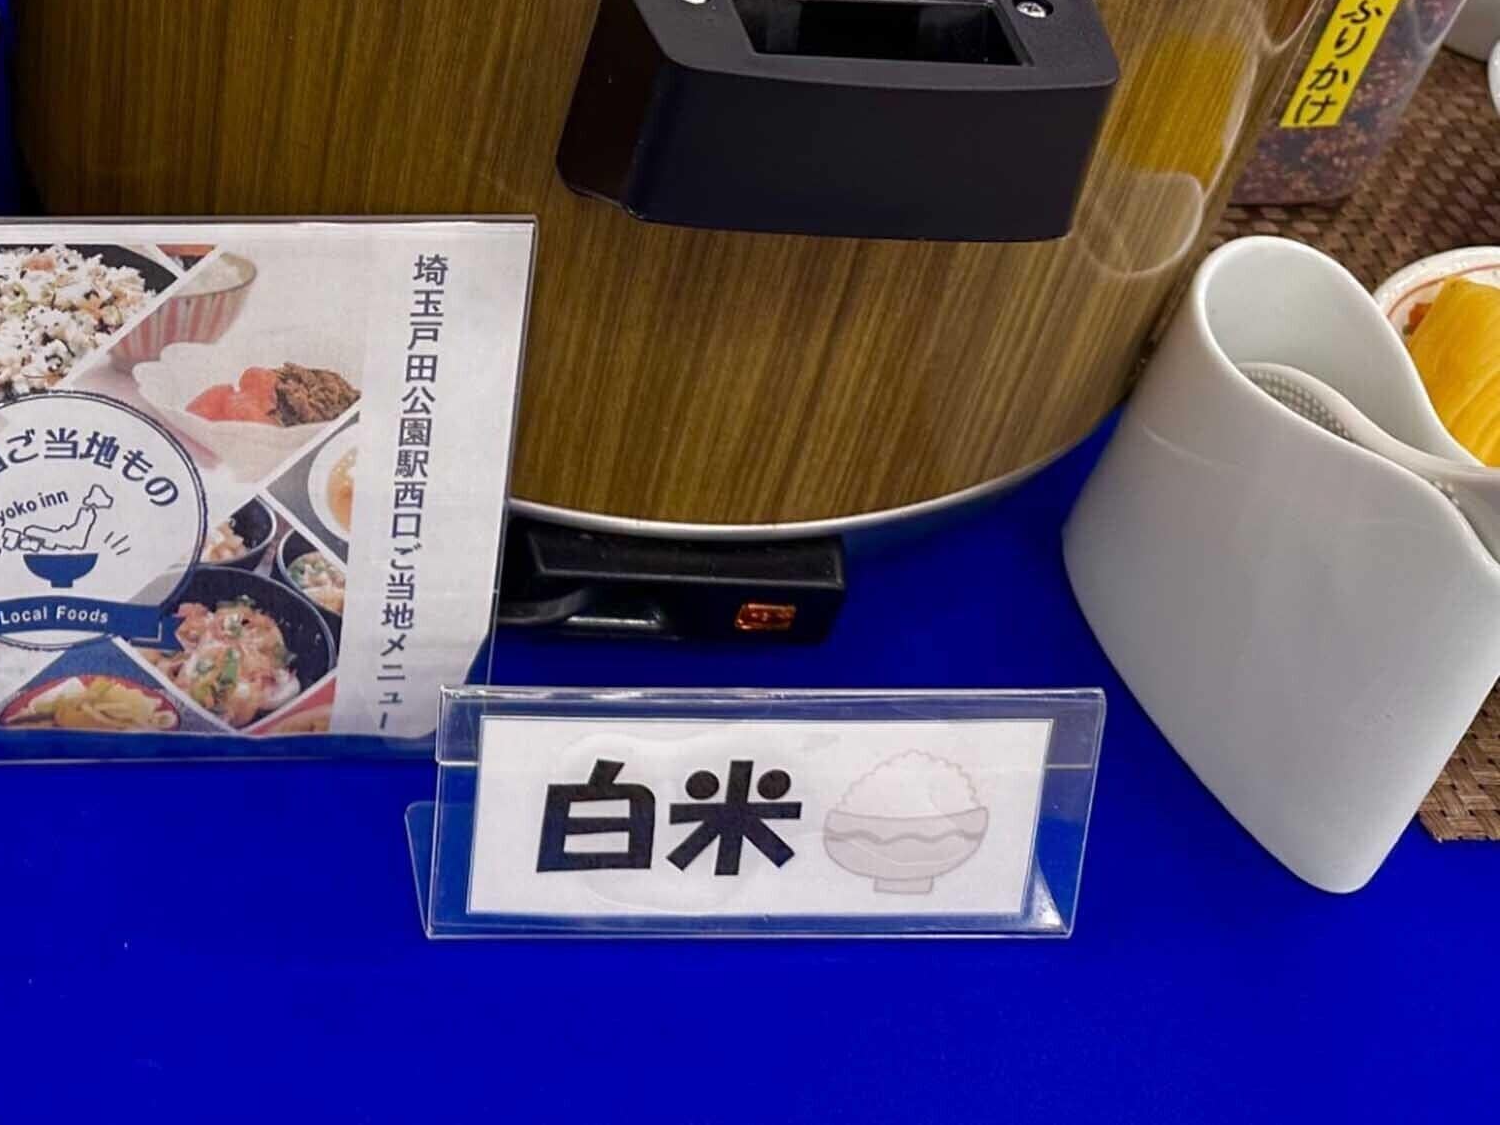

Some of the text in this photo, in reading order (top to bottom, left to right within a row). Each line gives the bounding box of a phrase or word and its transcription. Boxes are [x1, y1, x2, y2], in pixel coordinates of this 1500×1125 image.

[39, 488, 69, 509] inn
[376, 253, 449, 730] 埼玉戸田公園駅西口ご当地メニュー
[0, 605, 109, 625] Local Foods
[535, 758, 803, 876] 白米
